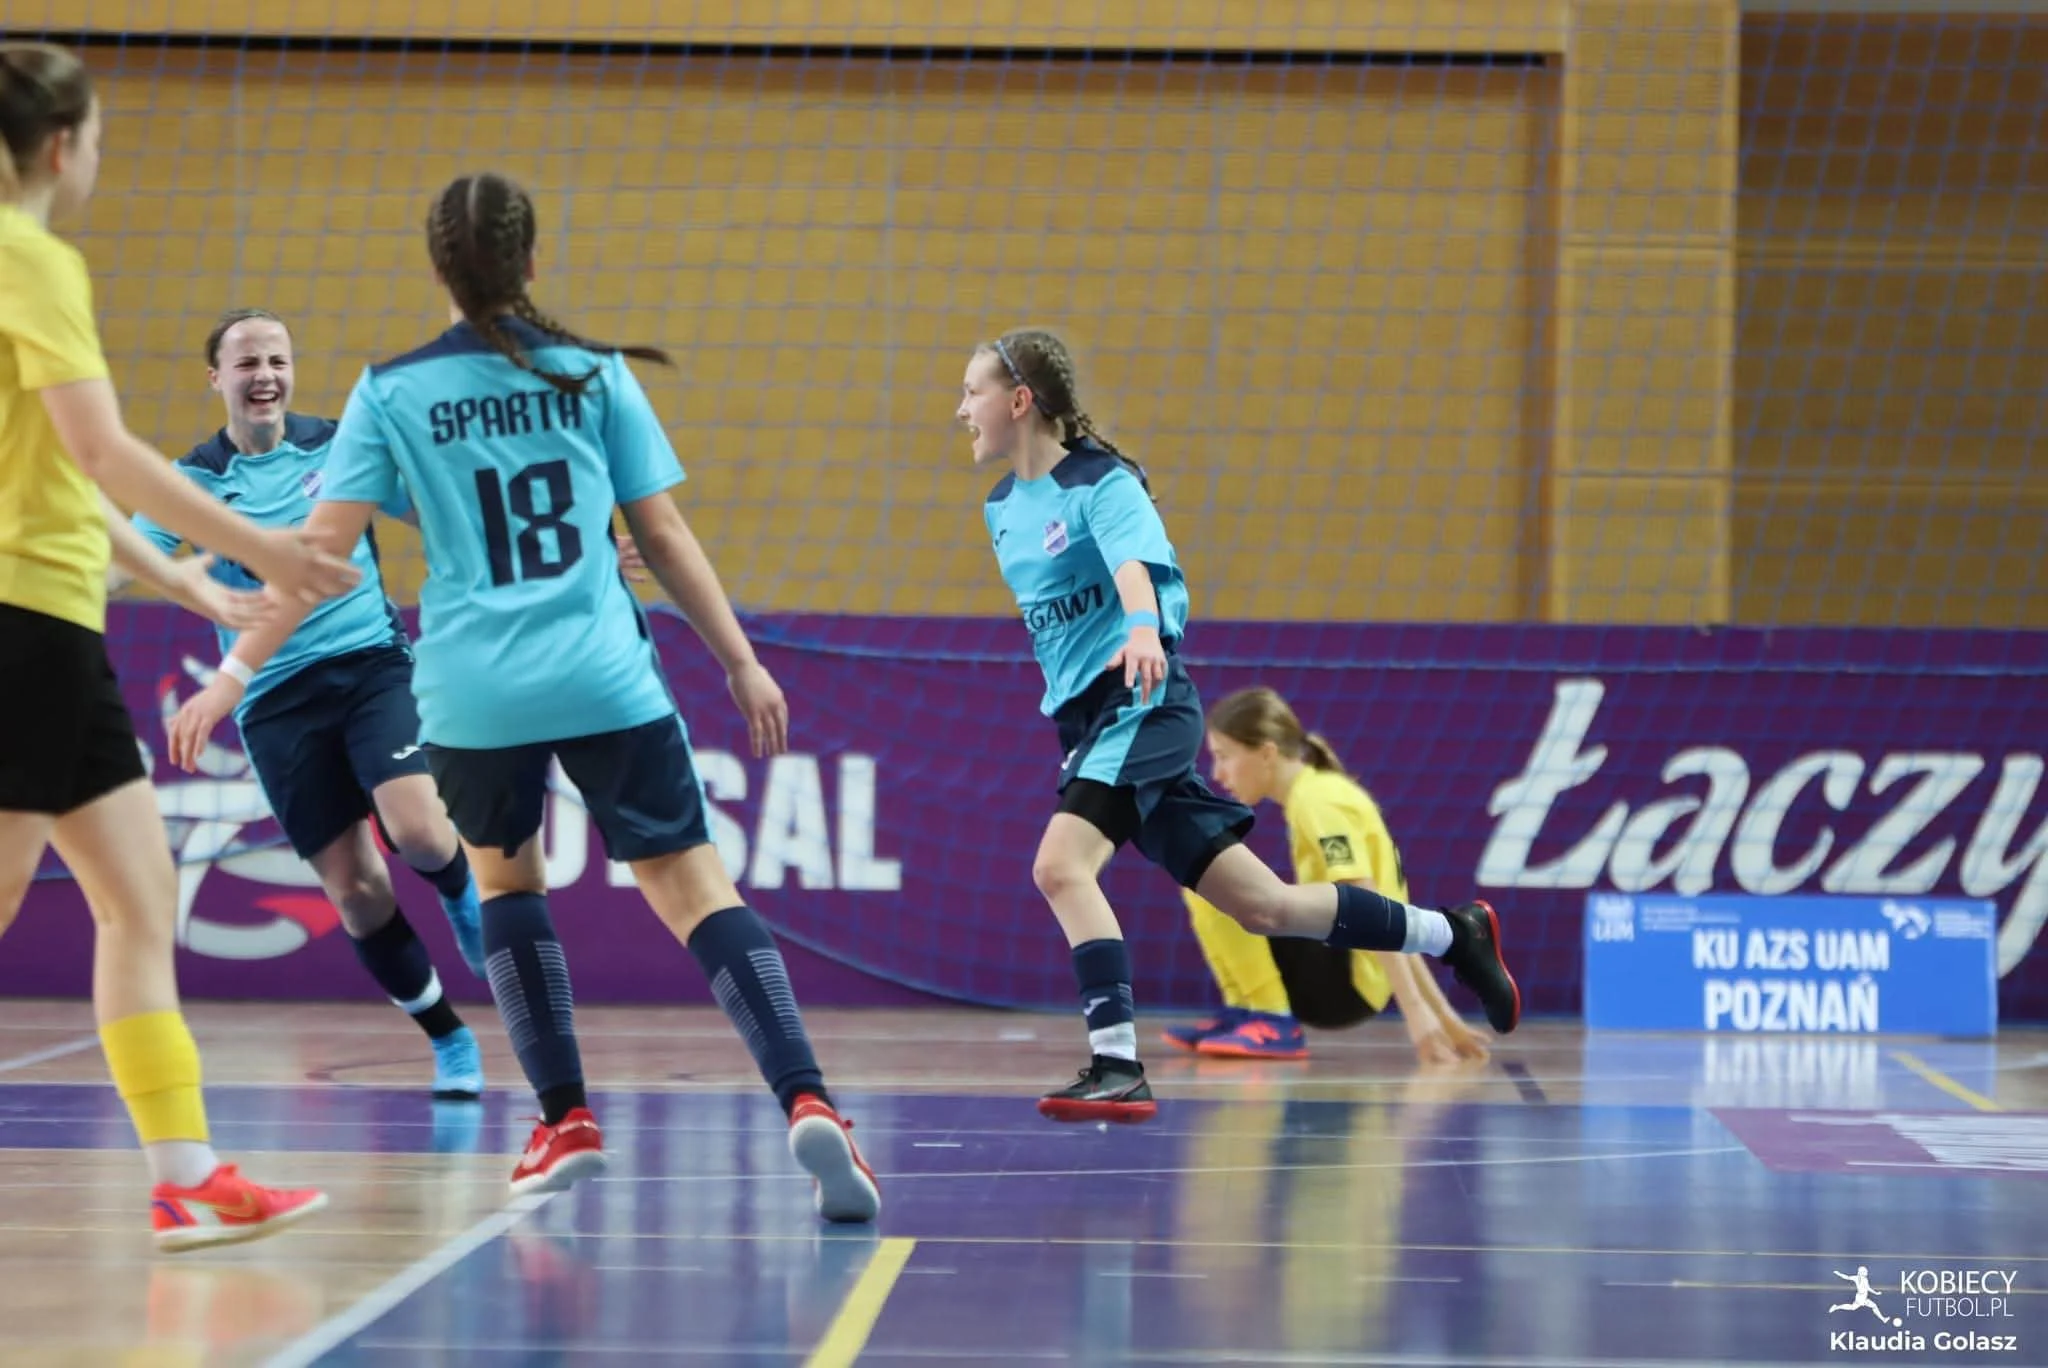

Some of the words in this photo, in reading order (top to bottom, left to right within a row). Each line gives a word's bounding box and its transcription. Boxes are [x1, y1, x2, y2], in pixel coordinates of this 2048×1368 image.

[429, 391, 582, 446] SPARTA
[475, 460, 583, 587] 18
[1023, 583, 1104, 632] GAWI
[1693, 928, 1739, 970] KU
[1745, 929, 1809, 970] AZS
[1814, 930, 1889, 972] UAM
[1704, 973, 1878, 1032] POZNAŃ
